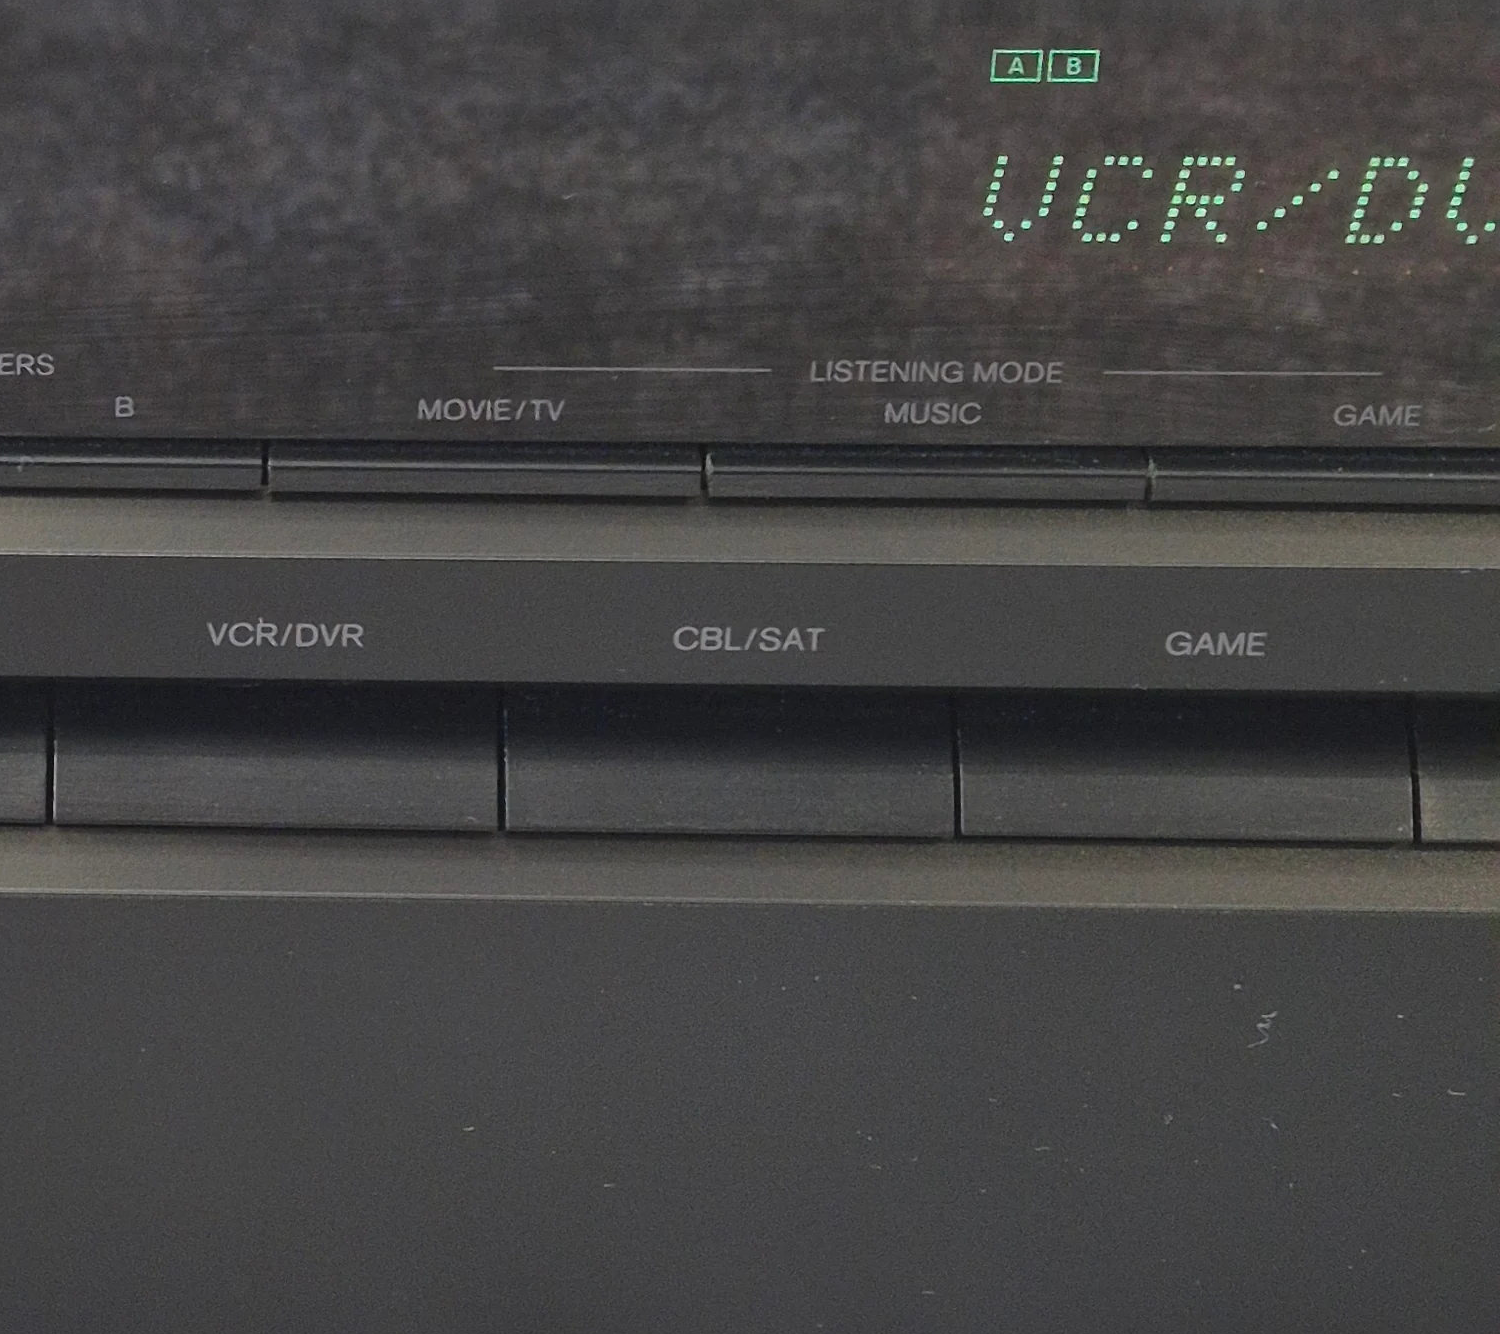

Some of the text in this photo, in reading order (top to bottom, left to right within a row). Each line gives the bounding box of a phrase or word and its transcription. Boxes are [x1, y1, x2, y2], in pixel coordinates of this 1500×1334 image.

[1008, 57, 1026, 76] A
[1065, 57, 1083, 76] B
[809, 361, 1063, 385] LISTENING MODE
[115, 396, 134, 418] B
[417, 399, 565, 423] MOVIE/TV
[884, 402, 982, 426] MUSIC
[1333, 404, 1421, 428] GAME
[206, 621, 365, 650] VCR/DVR
[672, 626, 826, 654] CBL/SAT
[1165, 631, 1268, 658] GAME
